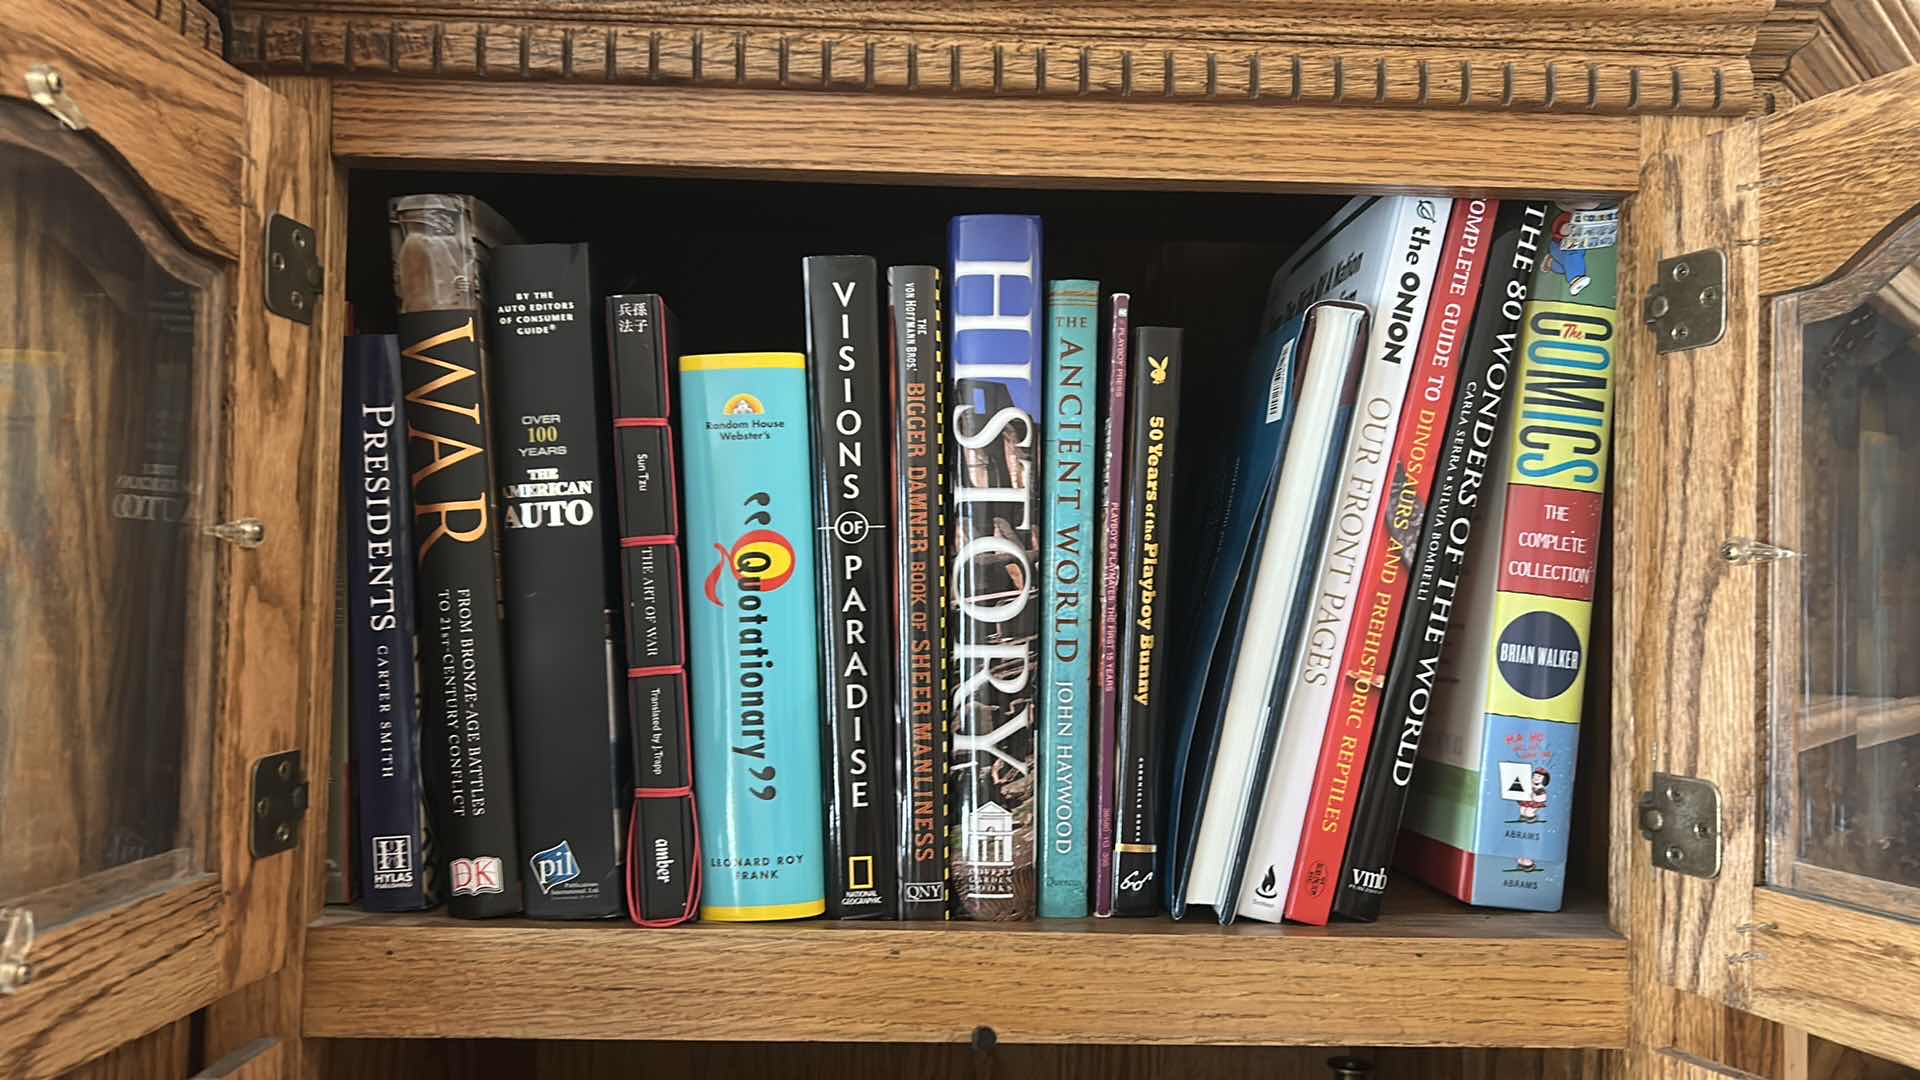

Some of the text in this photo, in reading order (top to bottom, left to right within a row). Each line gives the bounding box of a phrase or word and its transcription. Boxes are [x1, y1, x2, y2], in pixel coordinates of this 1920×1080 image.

[497, 301, 575, 313] AUTO EDITORS
[515, 291, 554, 301] BY THE
[1382, 225, 1431, 365] the ONION
[499, 313, 574, 325] OF CONSUMER
[917, 318, 928, 335] THE
[1055, 316, 1088, 329] THE
[1561, 323, 1585, 340] The
[832, 281, 862, 499] VISIONS
[1515, 310, 1614, 485] COMICS
[521, 414, 561, 425] OVER
[705, 419, 785, 430] Random House
[401, 317, 488, 561] WAR
[528, 426, 558, 443] 100
[720, 430, 771, 441] Webster's
[518, 446, 567, 457] YEARS
[526, 467, 559, 481] THE
[637, 453, 650, 491] Sun Tzu
[1053, 339, 1084, 663] ANCIENT WORLD
[1392, 205, 1548, 787] THE 80 WONDERS OF THE WORLD
[1417, 381, 1477, 601] CARLA SERRA SILVIA BOMBELLI
[362, 403, 397, 632] PRESIDENTS
[504, 499, 594, 529] AUTO
[952, 259, 1034, 775] HISTORY
[1321, 198, 1487, 834] OMPLETE GUIDE TO DINOSAURS AND PREHISTORIC REPTILES
[1544, 504, 1570, 522] THE
[839, 520, 864, 535] OF
[1304, 397, 1392, 688] OUR FRONT PAGES
[1518, 532, 1588, 554] COMPLETE
[1133, 416, 1165, 706] 50 Years of the Playboy Bunny
[1508, 560, 1591, 585] COLLECTION
[641, 547, 658, 656] THE ART OF WAR
[906, 383, 936, 863] BIGGER DAMNER BOOK OF SHEER MANLINESS
[1500, 643, 1579, 671] BRIAN WALKER
[841, 555, 869, 808] PARADISE
[376, 645, 395, 777] CARTER SMITH
[438, 588, 451, 612] TO
[448, 734, 465, 816] CONFLICT
[457, 588, 486, 816] FROM BRONZE-AGE BATTLES
[650, 688, 663, 730] Translated
[650, 732, 663, 743] by
[1055, 681, 1074, 855] JOHN HAYWOOD
[1505, 830, 1540, 840] ABRAMS
[453, 860, 496, 888] DK
[538, 850, 574, 885] pil
[655, 838, 675, 884] amber
[711, 855, 804, 868] LEONARD ROY
[735, 869, 779, 881] FRANK
[374, 871, 414, 883] HYLAS
[1352, 867, 1388, 890] vmb
[1503, 879, 1538, 890] ABRAMS
[907, 883, 941, 900] QNY
